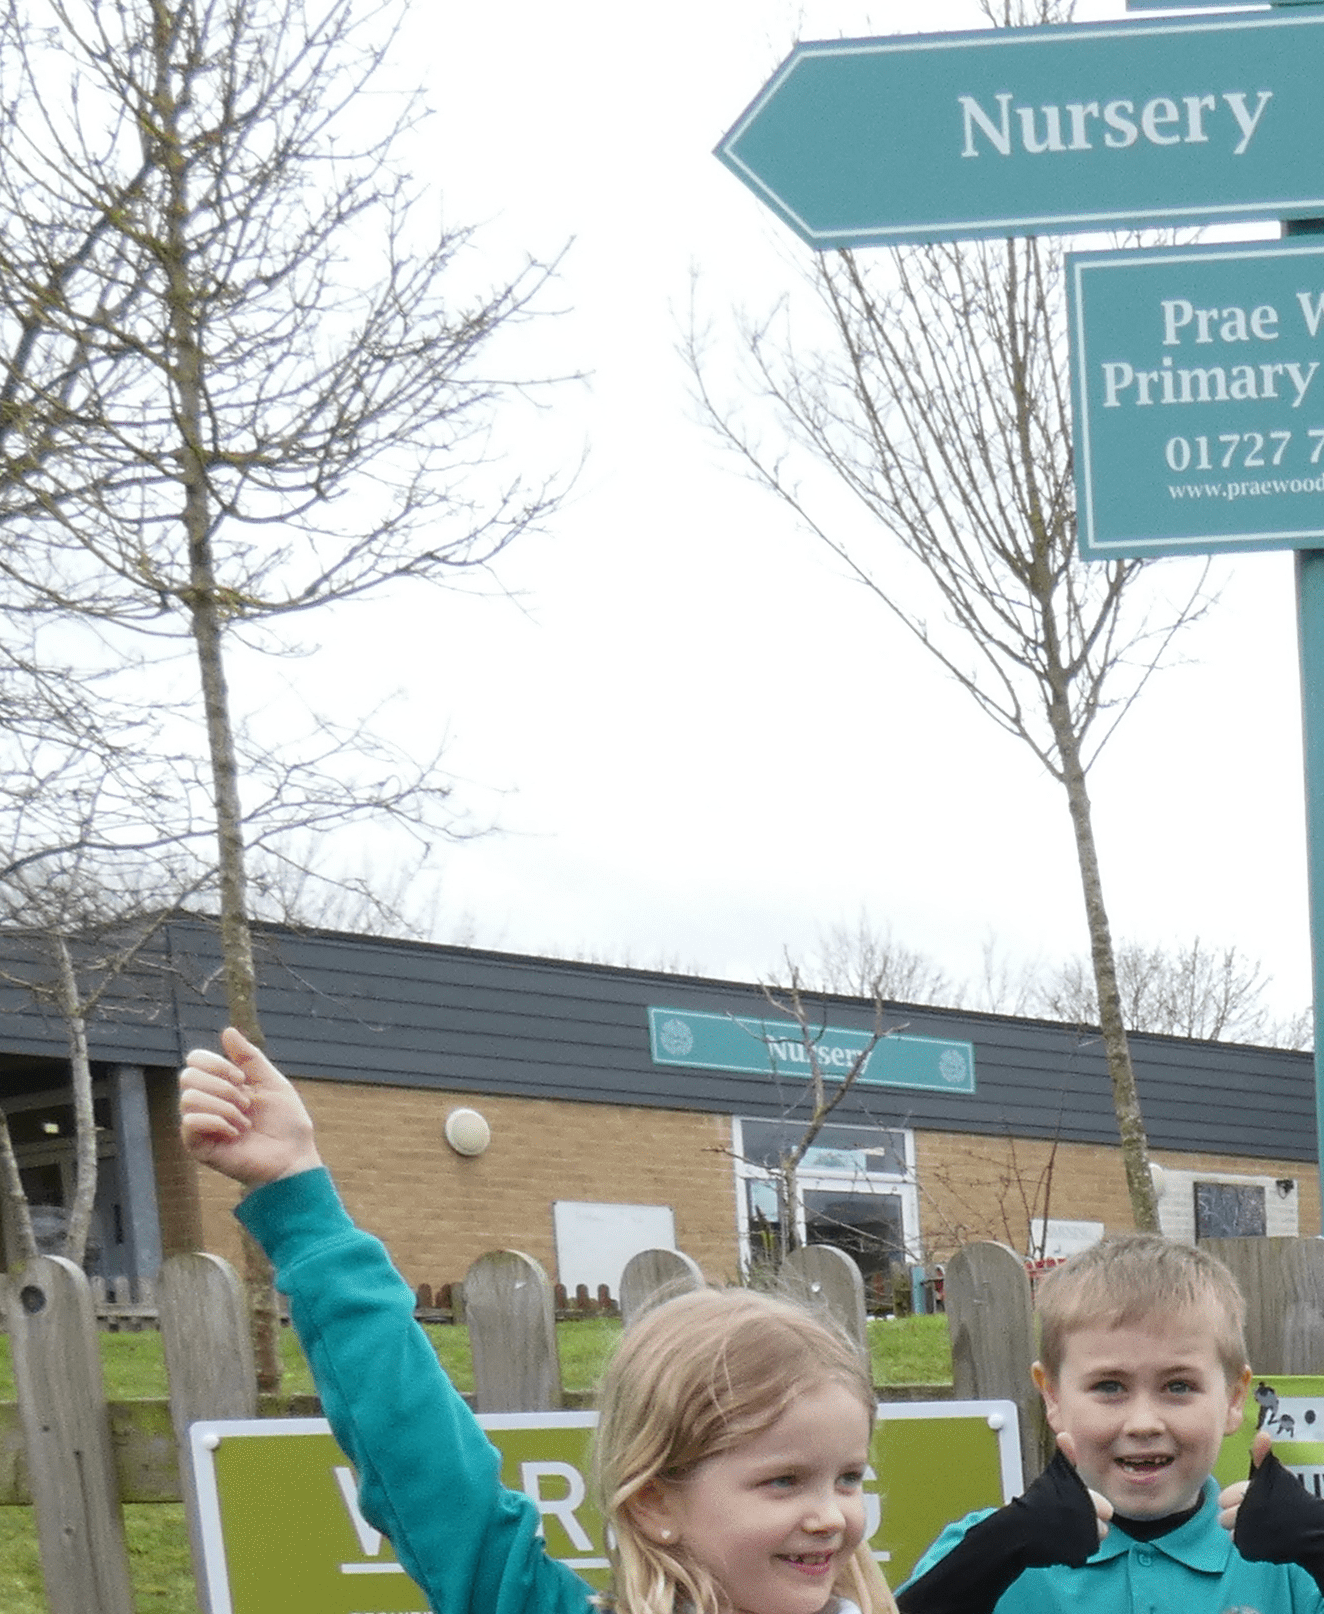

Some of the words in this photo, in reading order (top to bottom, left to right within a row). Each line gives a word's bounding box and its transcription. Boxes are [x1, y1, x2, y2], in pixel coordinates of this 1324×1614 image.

[958, 90, 1273, 158] Nursery
[1161, 298, 1279, 347] Prae
[1100, 353, 1321, 409] Primary
[1164, 429, 1292, 472] 01727
